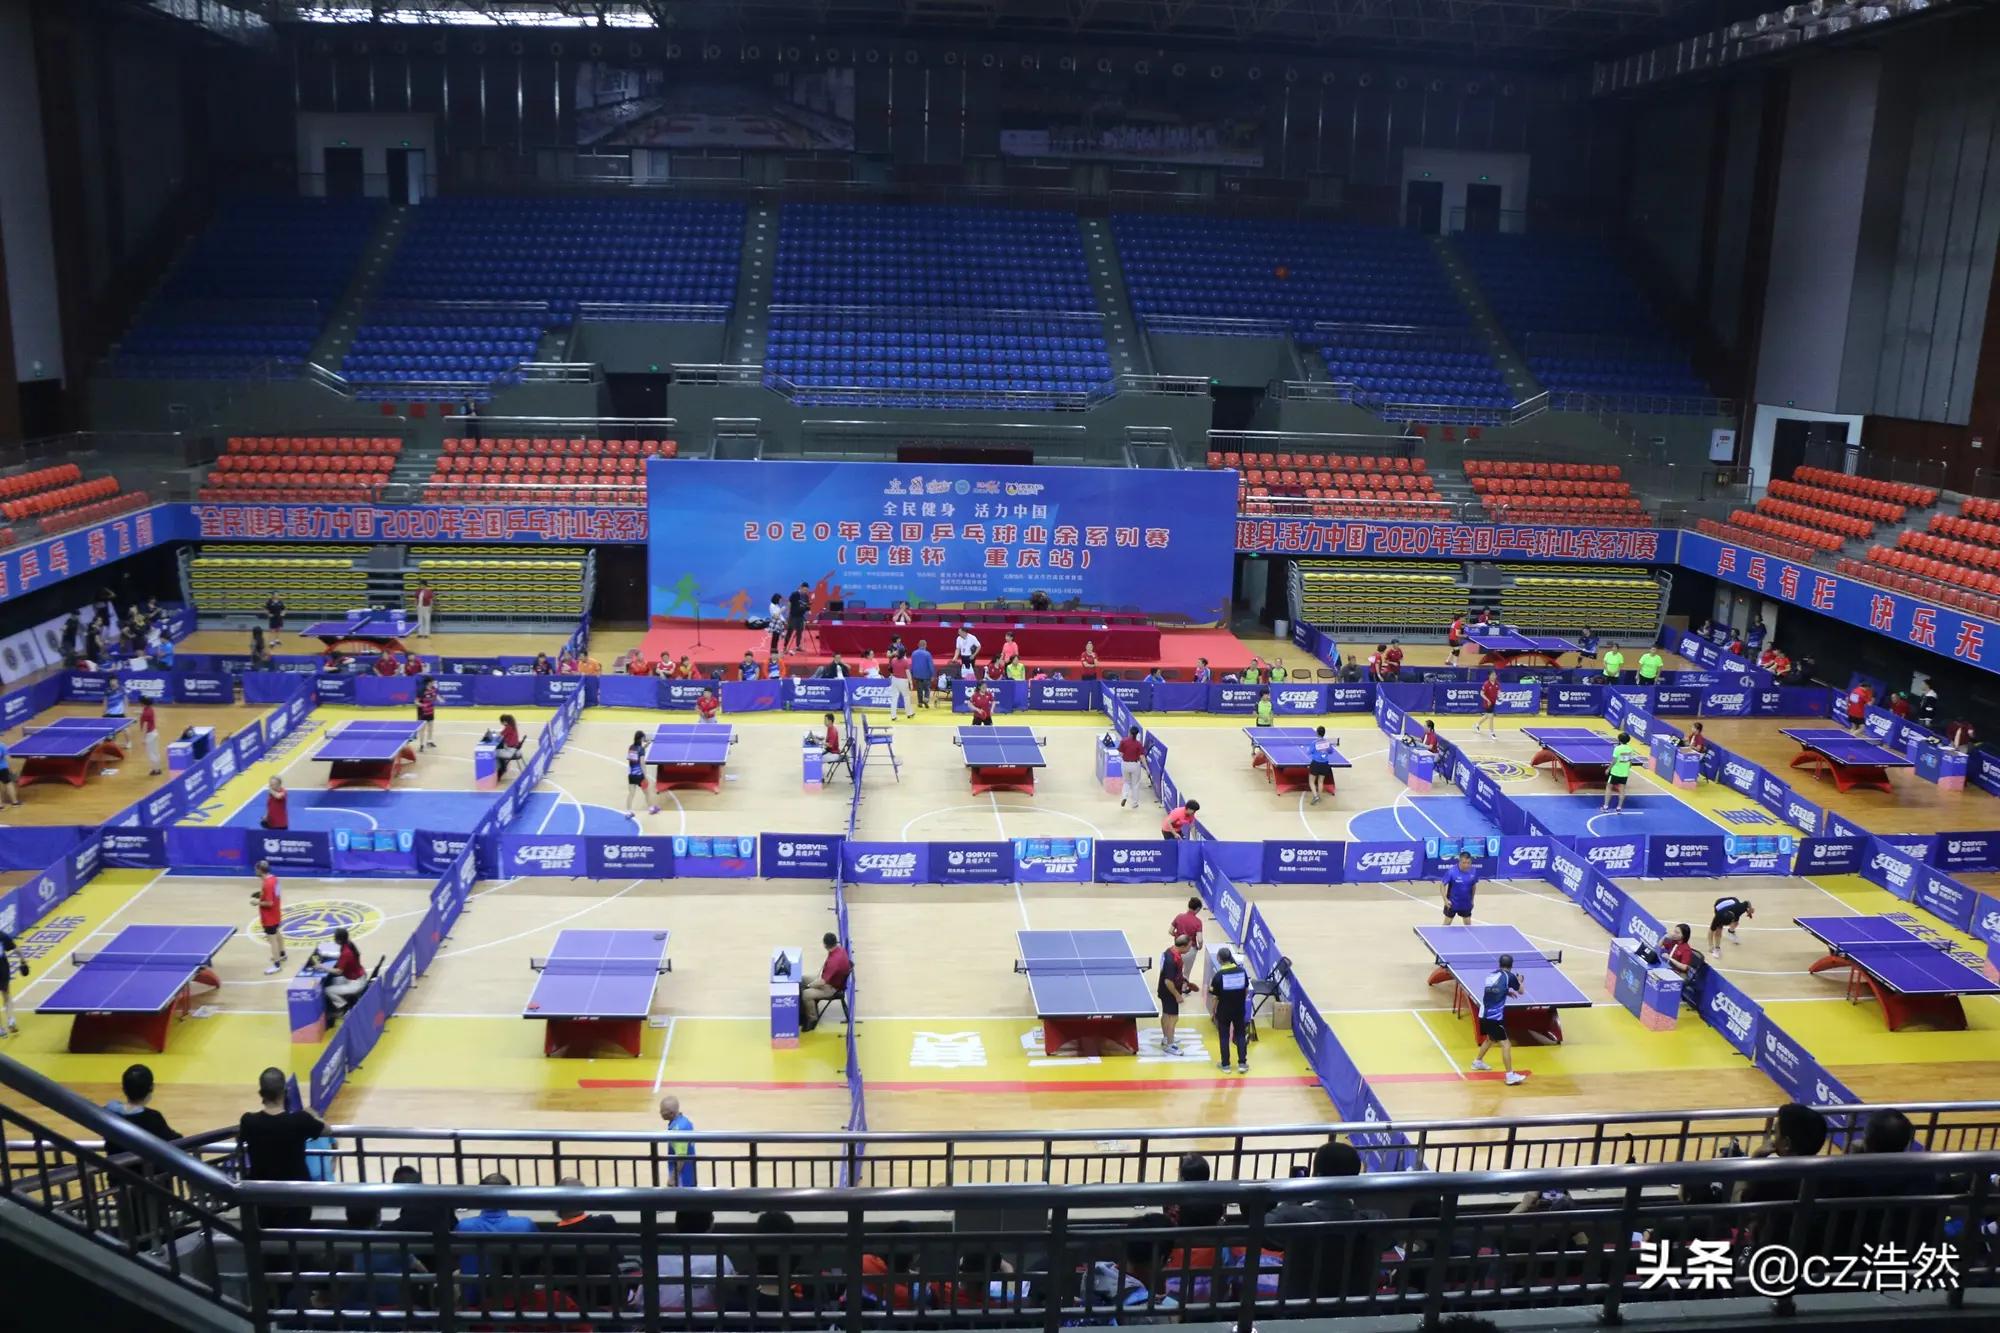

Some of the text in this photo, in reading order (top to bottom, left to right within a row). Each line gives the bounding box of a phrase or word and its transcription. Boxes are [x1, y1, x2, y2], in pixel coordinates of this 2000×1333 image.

[883, 501, 1048, 520] 全民健身 活力中国
[743, 521, 1170, 549] 2020年全国乒乓球业余系列赛
[1717, 547, 1984, 662] 乒乓有形 快乐无
[337, 833, 349, 847] 0
[401, 832, 412, 847] 0
[675, 838, 686, 853] 0
[740, 839, 752, 854] 0
[1078, 839, 1088, 855] 0
[1426, 840, 1436, 854] 0
[1488, 838, 1497, 853] 0
[1725, 838, 1733, 851] 0
[1779, 837, 1788, 849] 0
[1356, 851, 1415, 871] 红双喜
[1585, 844, 1635, 863] 红双喜
[854, 853, 917, 874] 红双喜
[1380, 864, 1413, 875] DHS
